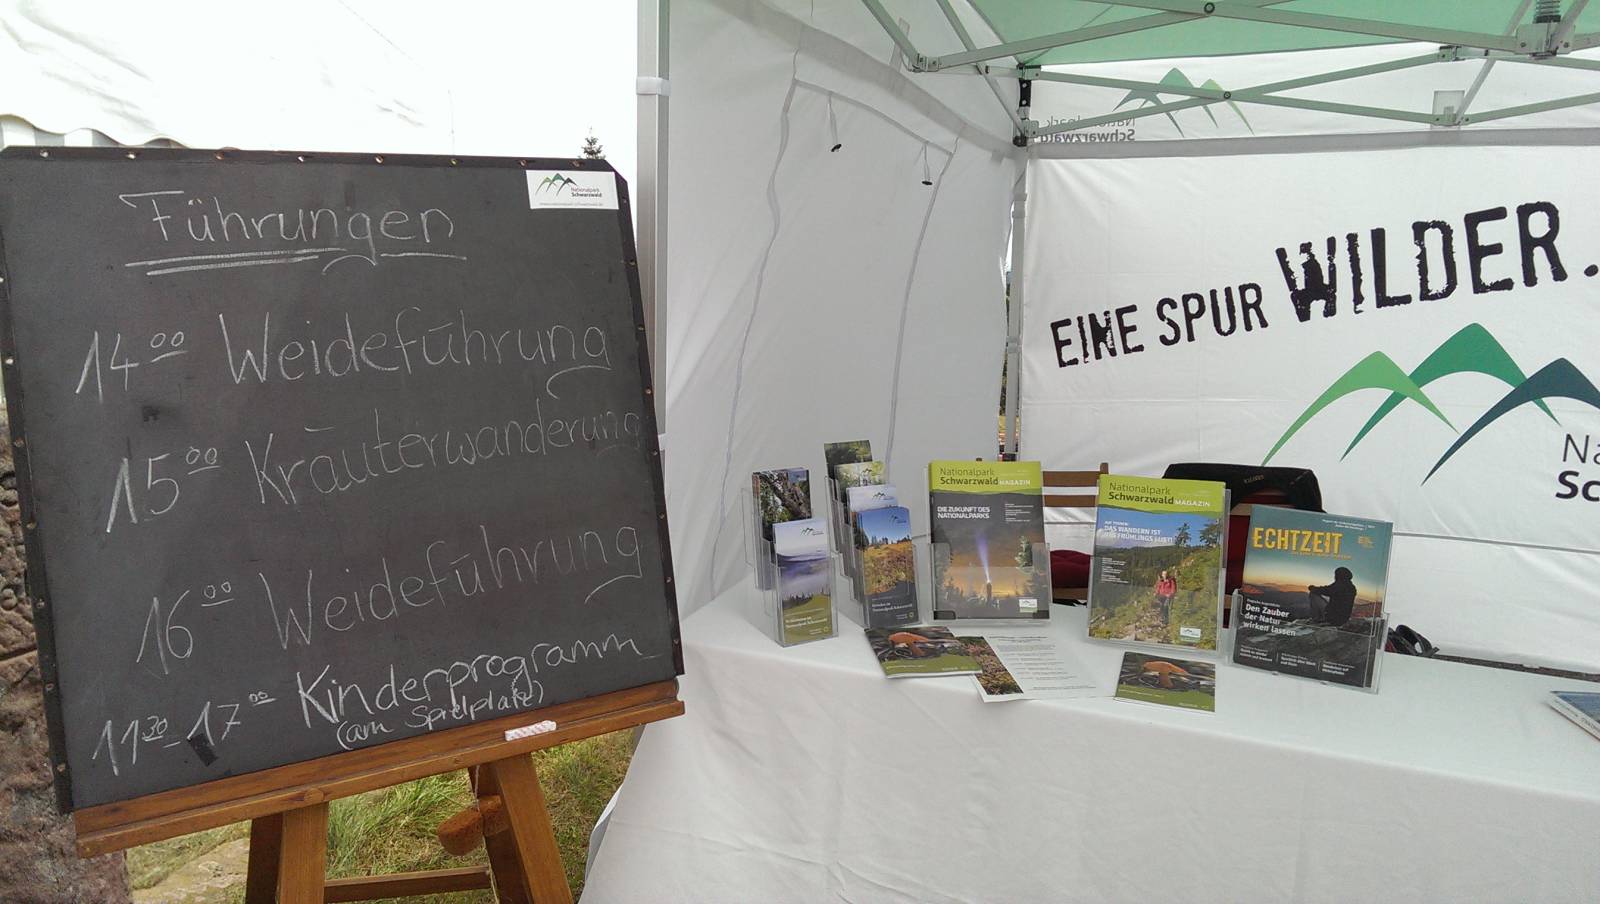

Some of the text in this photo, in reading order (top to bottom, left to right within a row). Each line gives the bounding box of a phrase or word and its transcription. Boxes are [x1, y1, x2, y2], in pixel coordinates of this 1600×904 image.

[118, 190, 454, 267] Führungen
[1050, 201, 1599, 368] EINE SPUR WILDER.
[219, 305, 612, 399] Weideführung
[245, 397, 641, 505] Kräuterwanderung
[940, 467, 995, 478] Nationalpark
[940, 476, 999, 486] Schwarzwald
[1109, 482, 1171, 496] Nationalpark
[1109, 491, 1211, 508] Schwarzwald MAGAZIN
[1252, 527, 1344, 555] ECHTZEIT
[258, 524, 643, 649] Weideführung
[1244, 612, 1281, 626] der Natur
[1245, 603, 1260, 613] Den
[1262, 606, 1290, 618] Zauber
[1243, 621, 1297, 637] wirken lassen
[296, 633, 642, 729] Kinderprogramm
